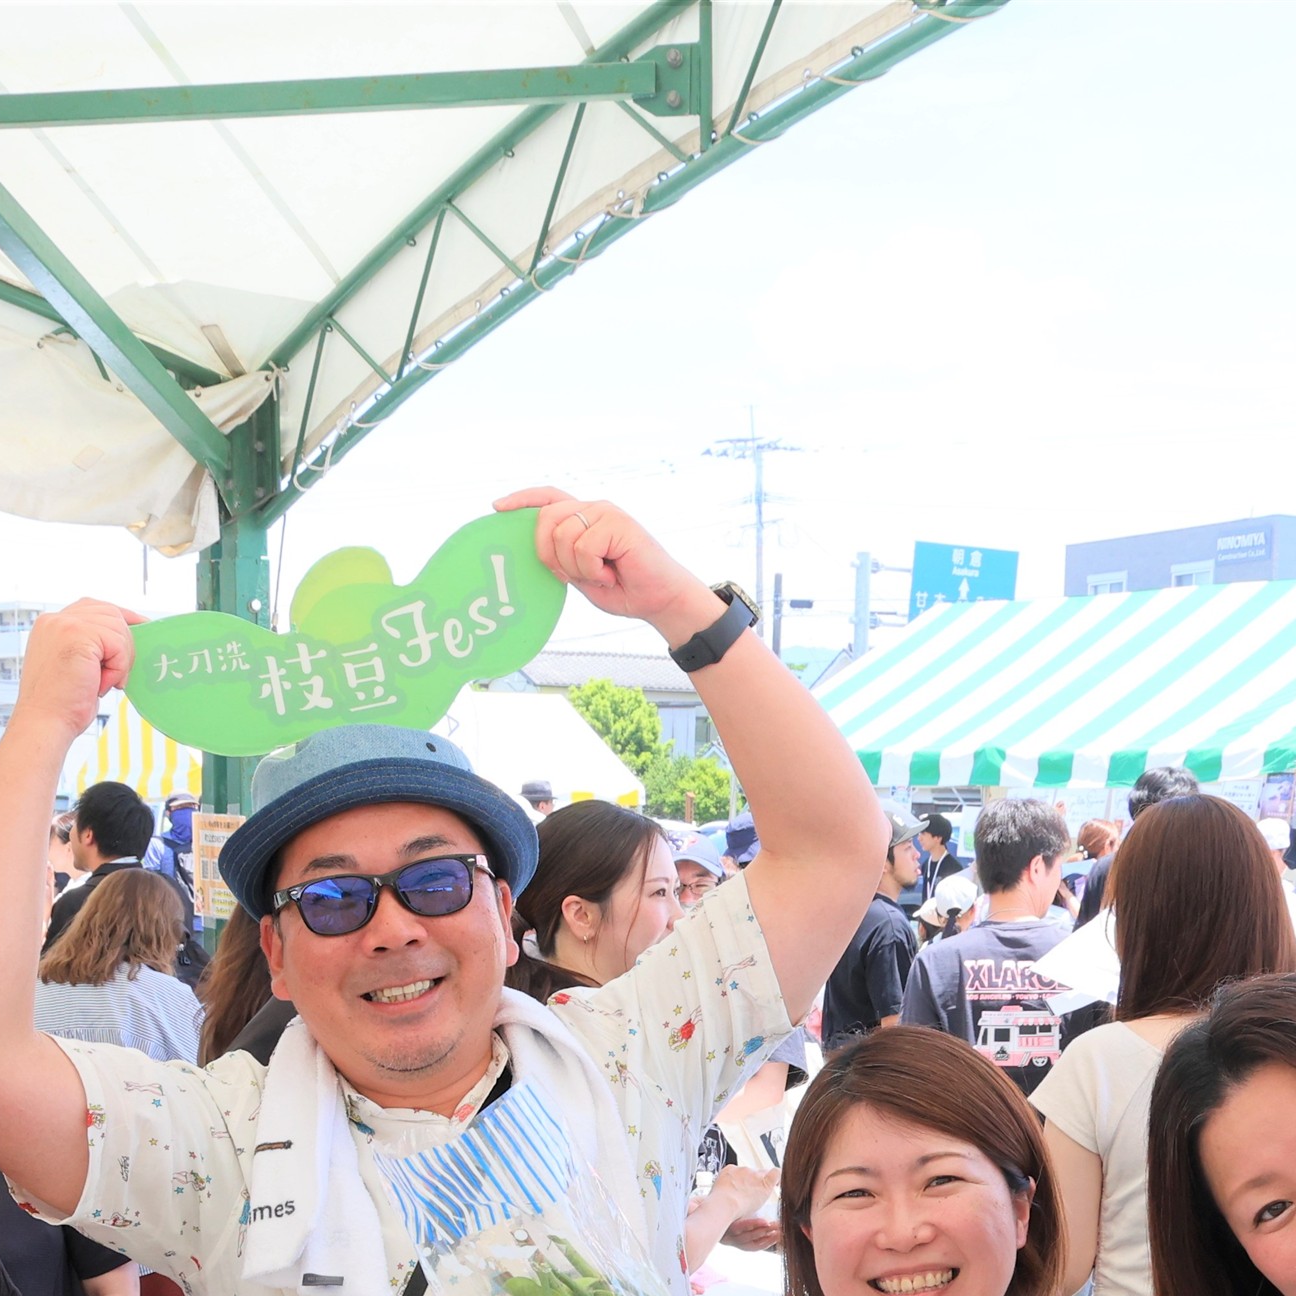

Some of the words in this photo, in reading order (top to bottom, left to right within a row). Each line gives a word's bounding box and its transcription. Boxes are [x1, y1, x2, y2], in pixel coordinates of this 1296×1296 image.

[153, 638, 252, 683] 大刀洗
[257, 642, 399, 716] 枝豆
[380, 553, 515, 668] Fes!
